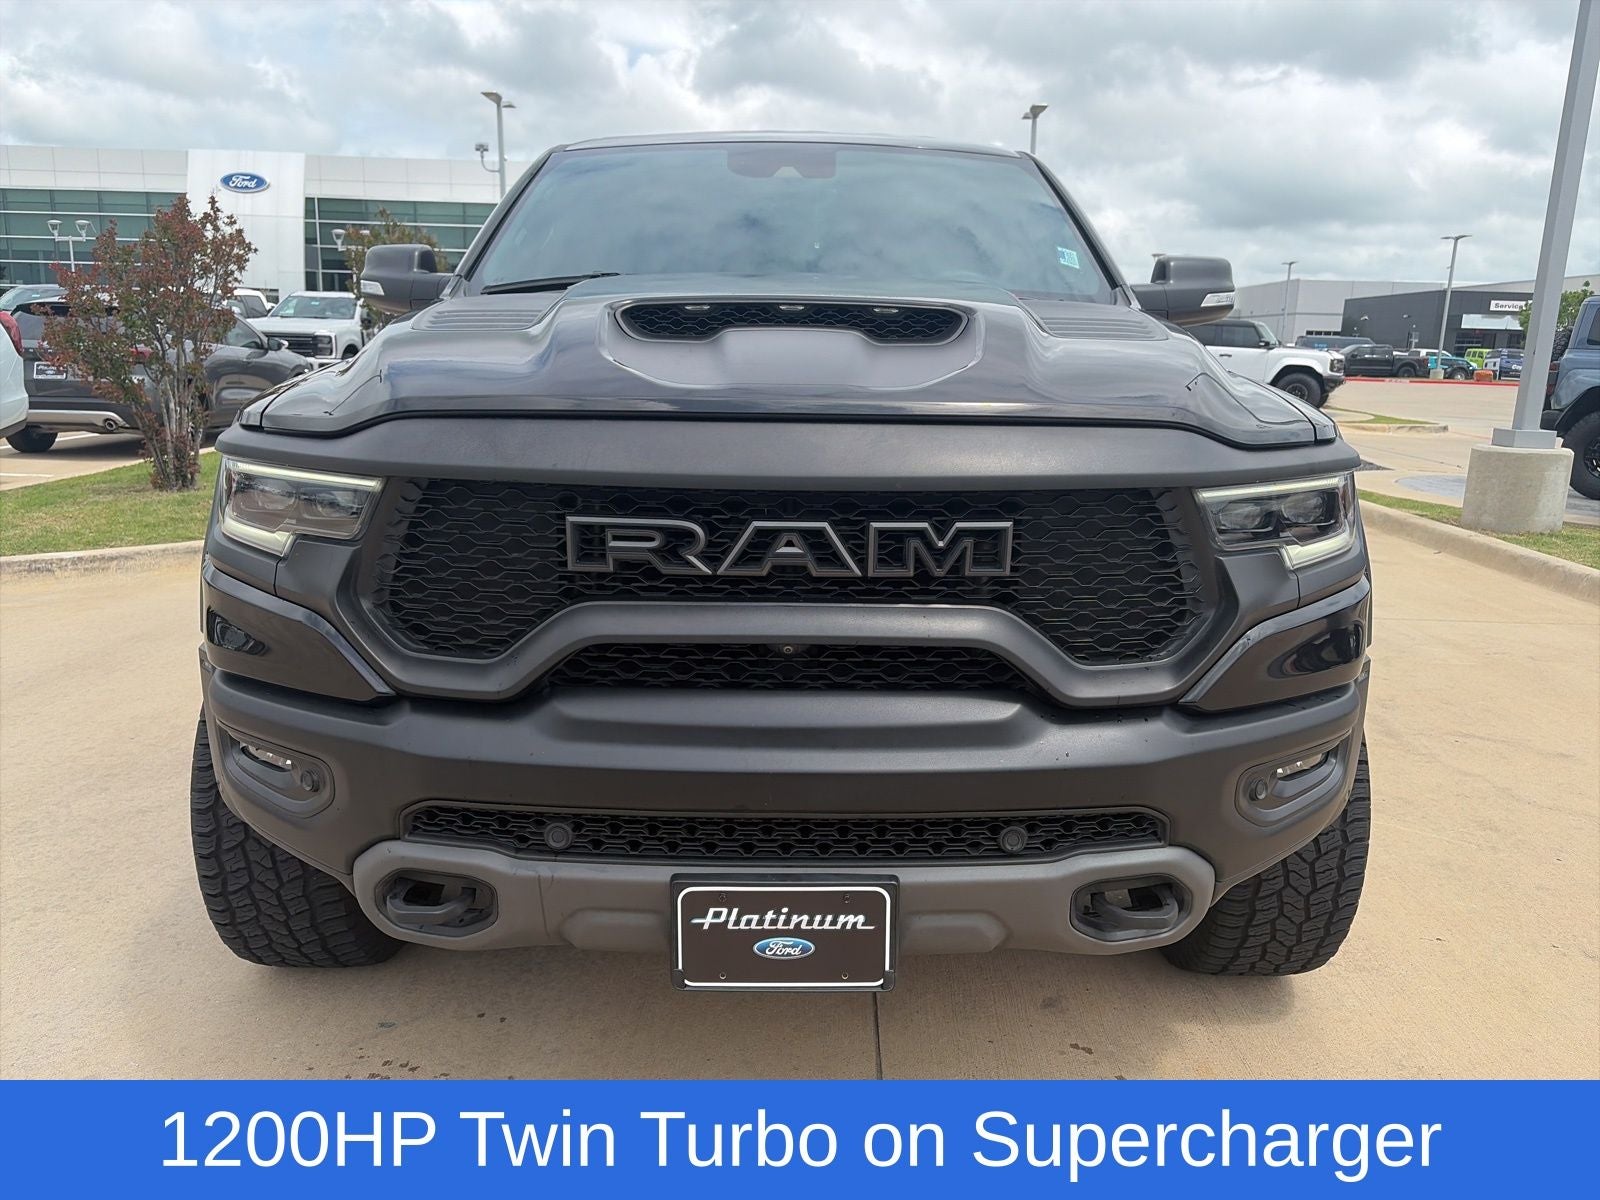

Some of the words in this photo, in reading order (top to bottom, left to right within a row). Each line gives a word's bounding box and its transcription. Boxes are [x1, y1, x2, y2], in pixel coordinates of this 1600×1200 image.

[229, 174, 258, 188] Ford
[566, 516, 1014, 577] RAM
[690, 907, 876, 930] Platinum
[765, 940, 803, 956] Ford
